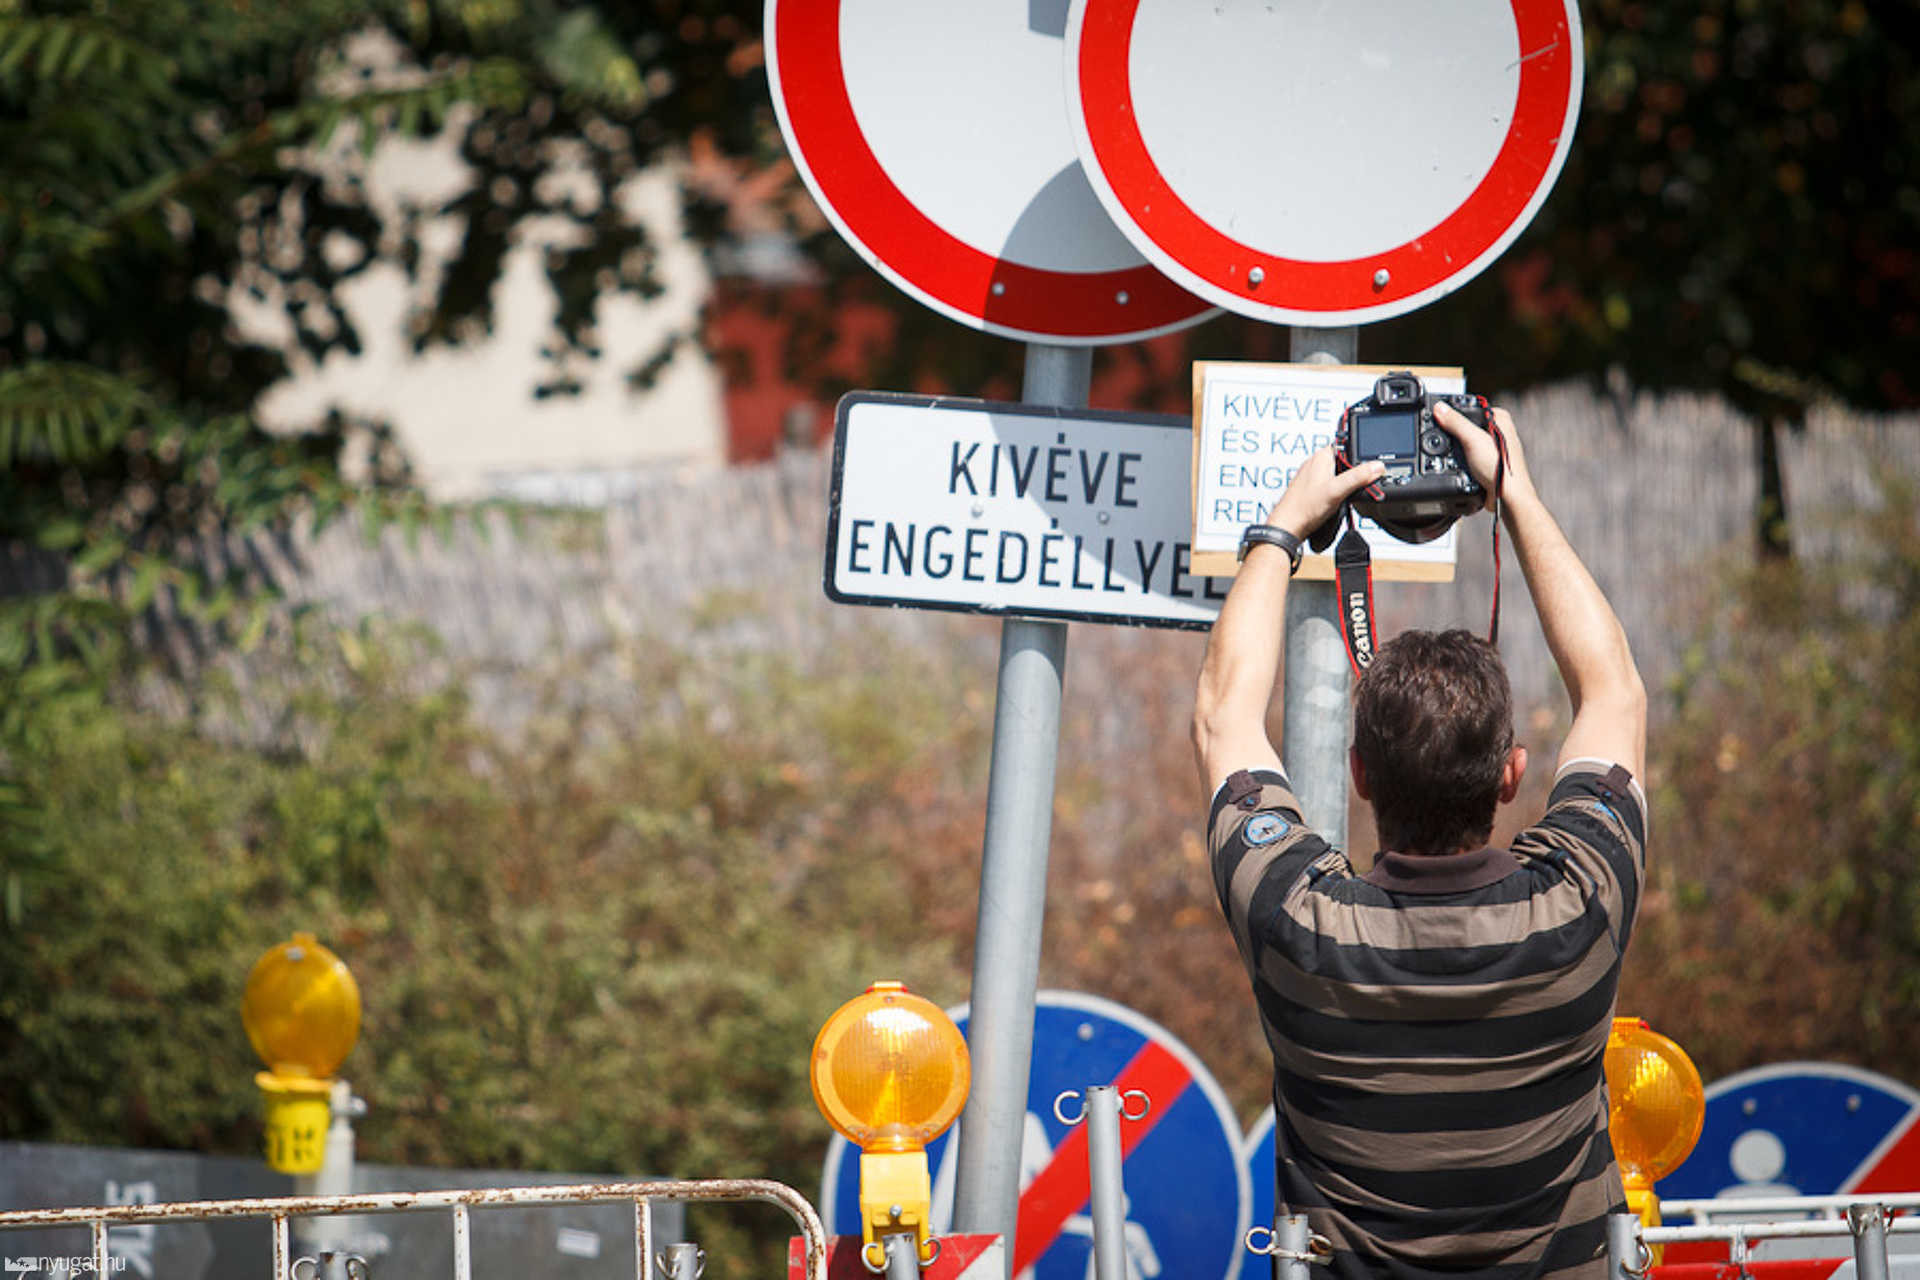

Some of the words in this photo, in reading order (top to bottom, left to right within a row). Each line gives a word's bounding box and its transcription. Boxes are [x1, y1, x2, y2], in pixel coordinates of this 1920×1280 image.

[1222, 391, 1332, 422] KIVÉVE
[1221, 424, 1260, 453] ÉS
[948, 432, 1143, 509] KIVÉVE
[1349, 592, 1375, 668] Canon
